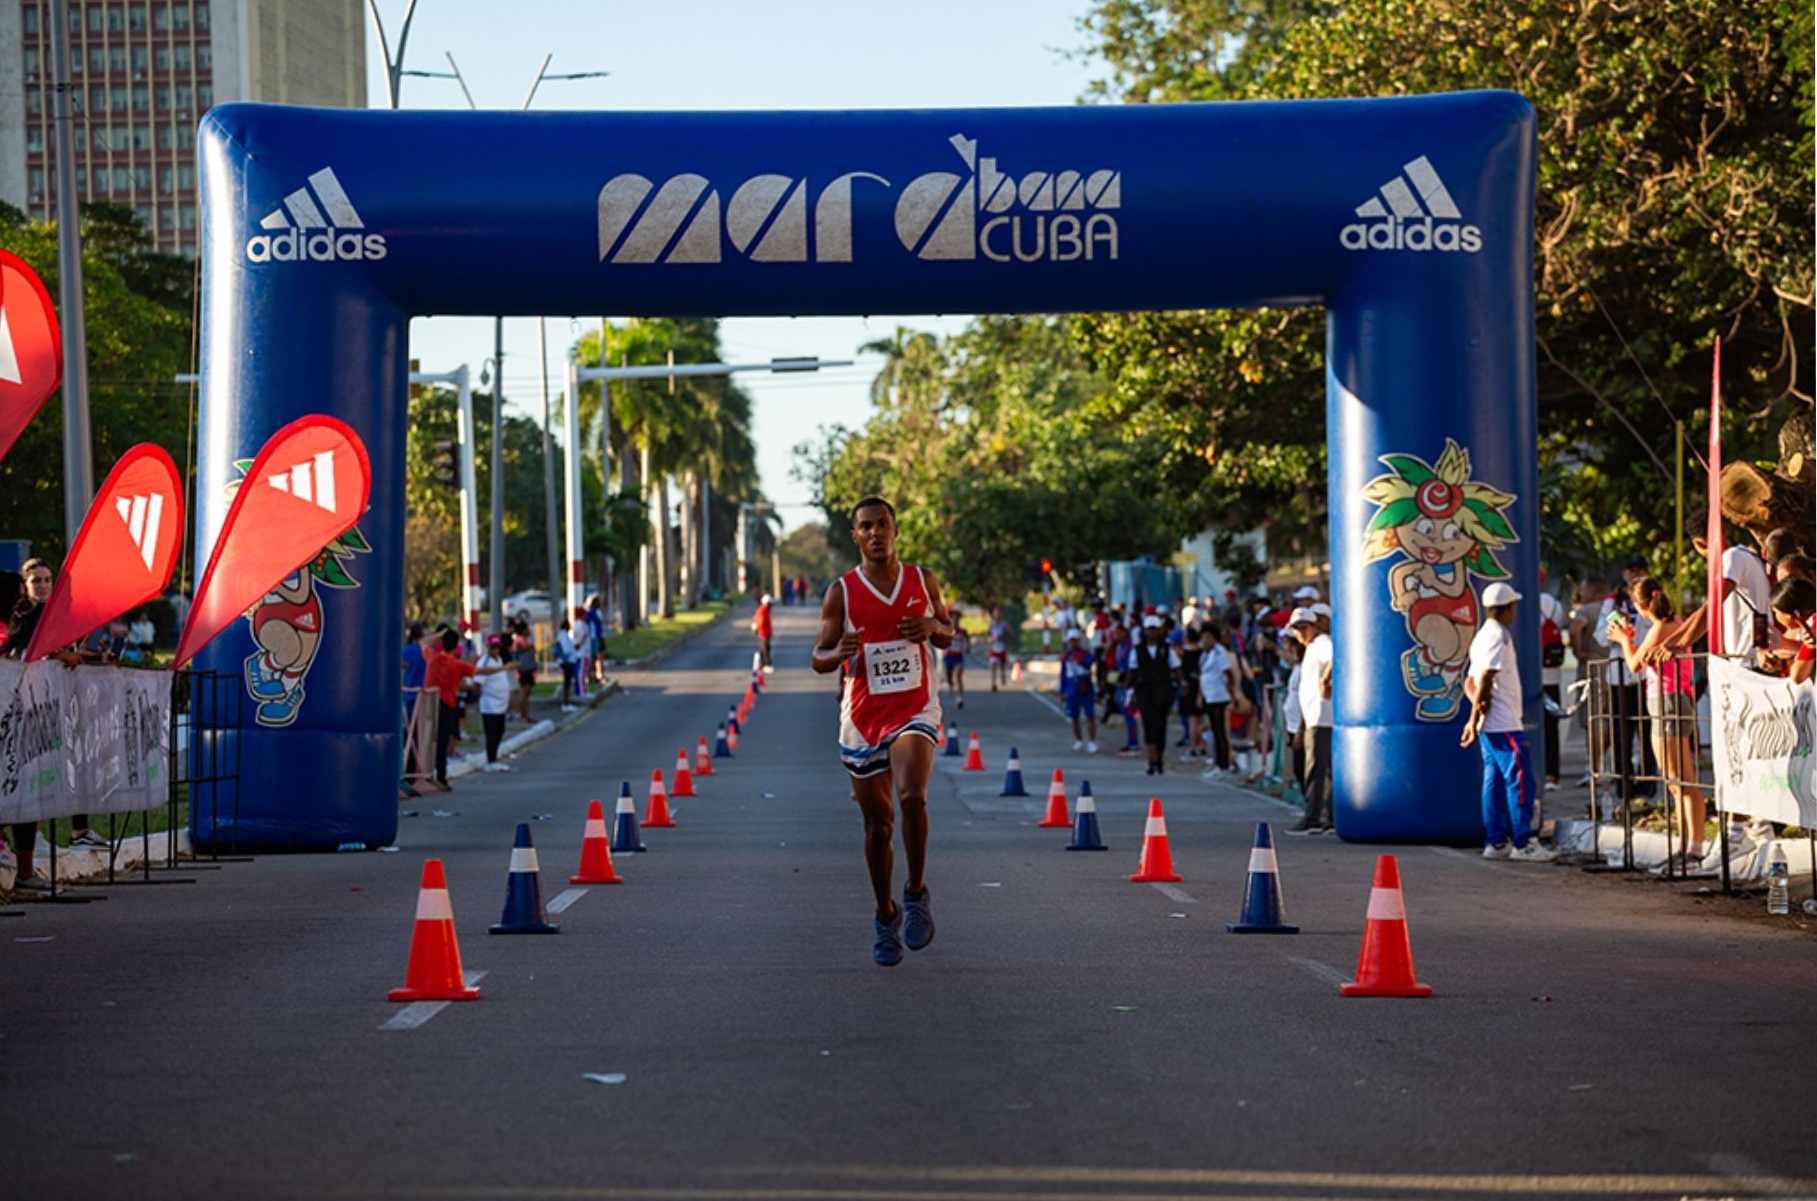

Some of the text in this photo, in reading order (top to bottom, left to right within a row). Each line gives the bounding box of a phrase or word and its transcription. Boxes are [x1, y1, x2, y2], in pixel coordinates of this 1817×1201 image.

[246, 226, 388, 262] adidas
[979, 213, 1119, 263] CUBA
[1339, 214, 1483, 253] adidas
[873, 658, 911, 677] 1322
